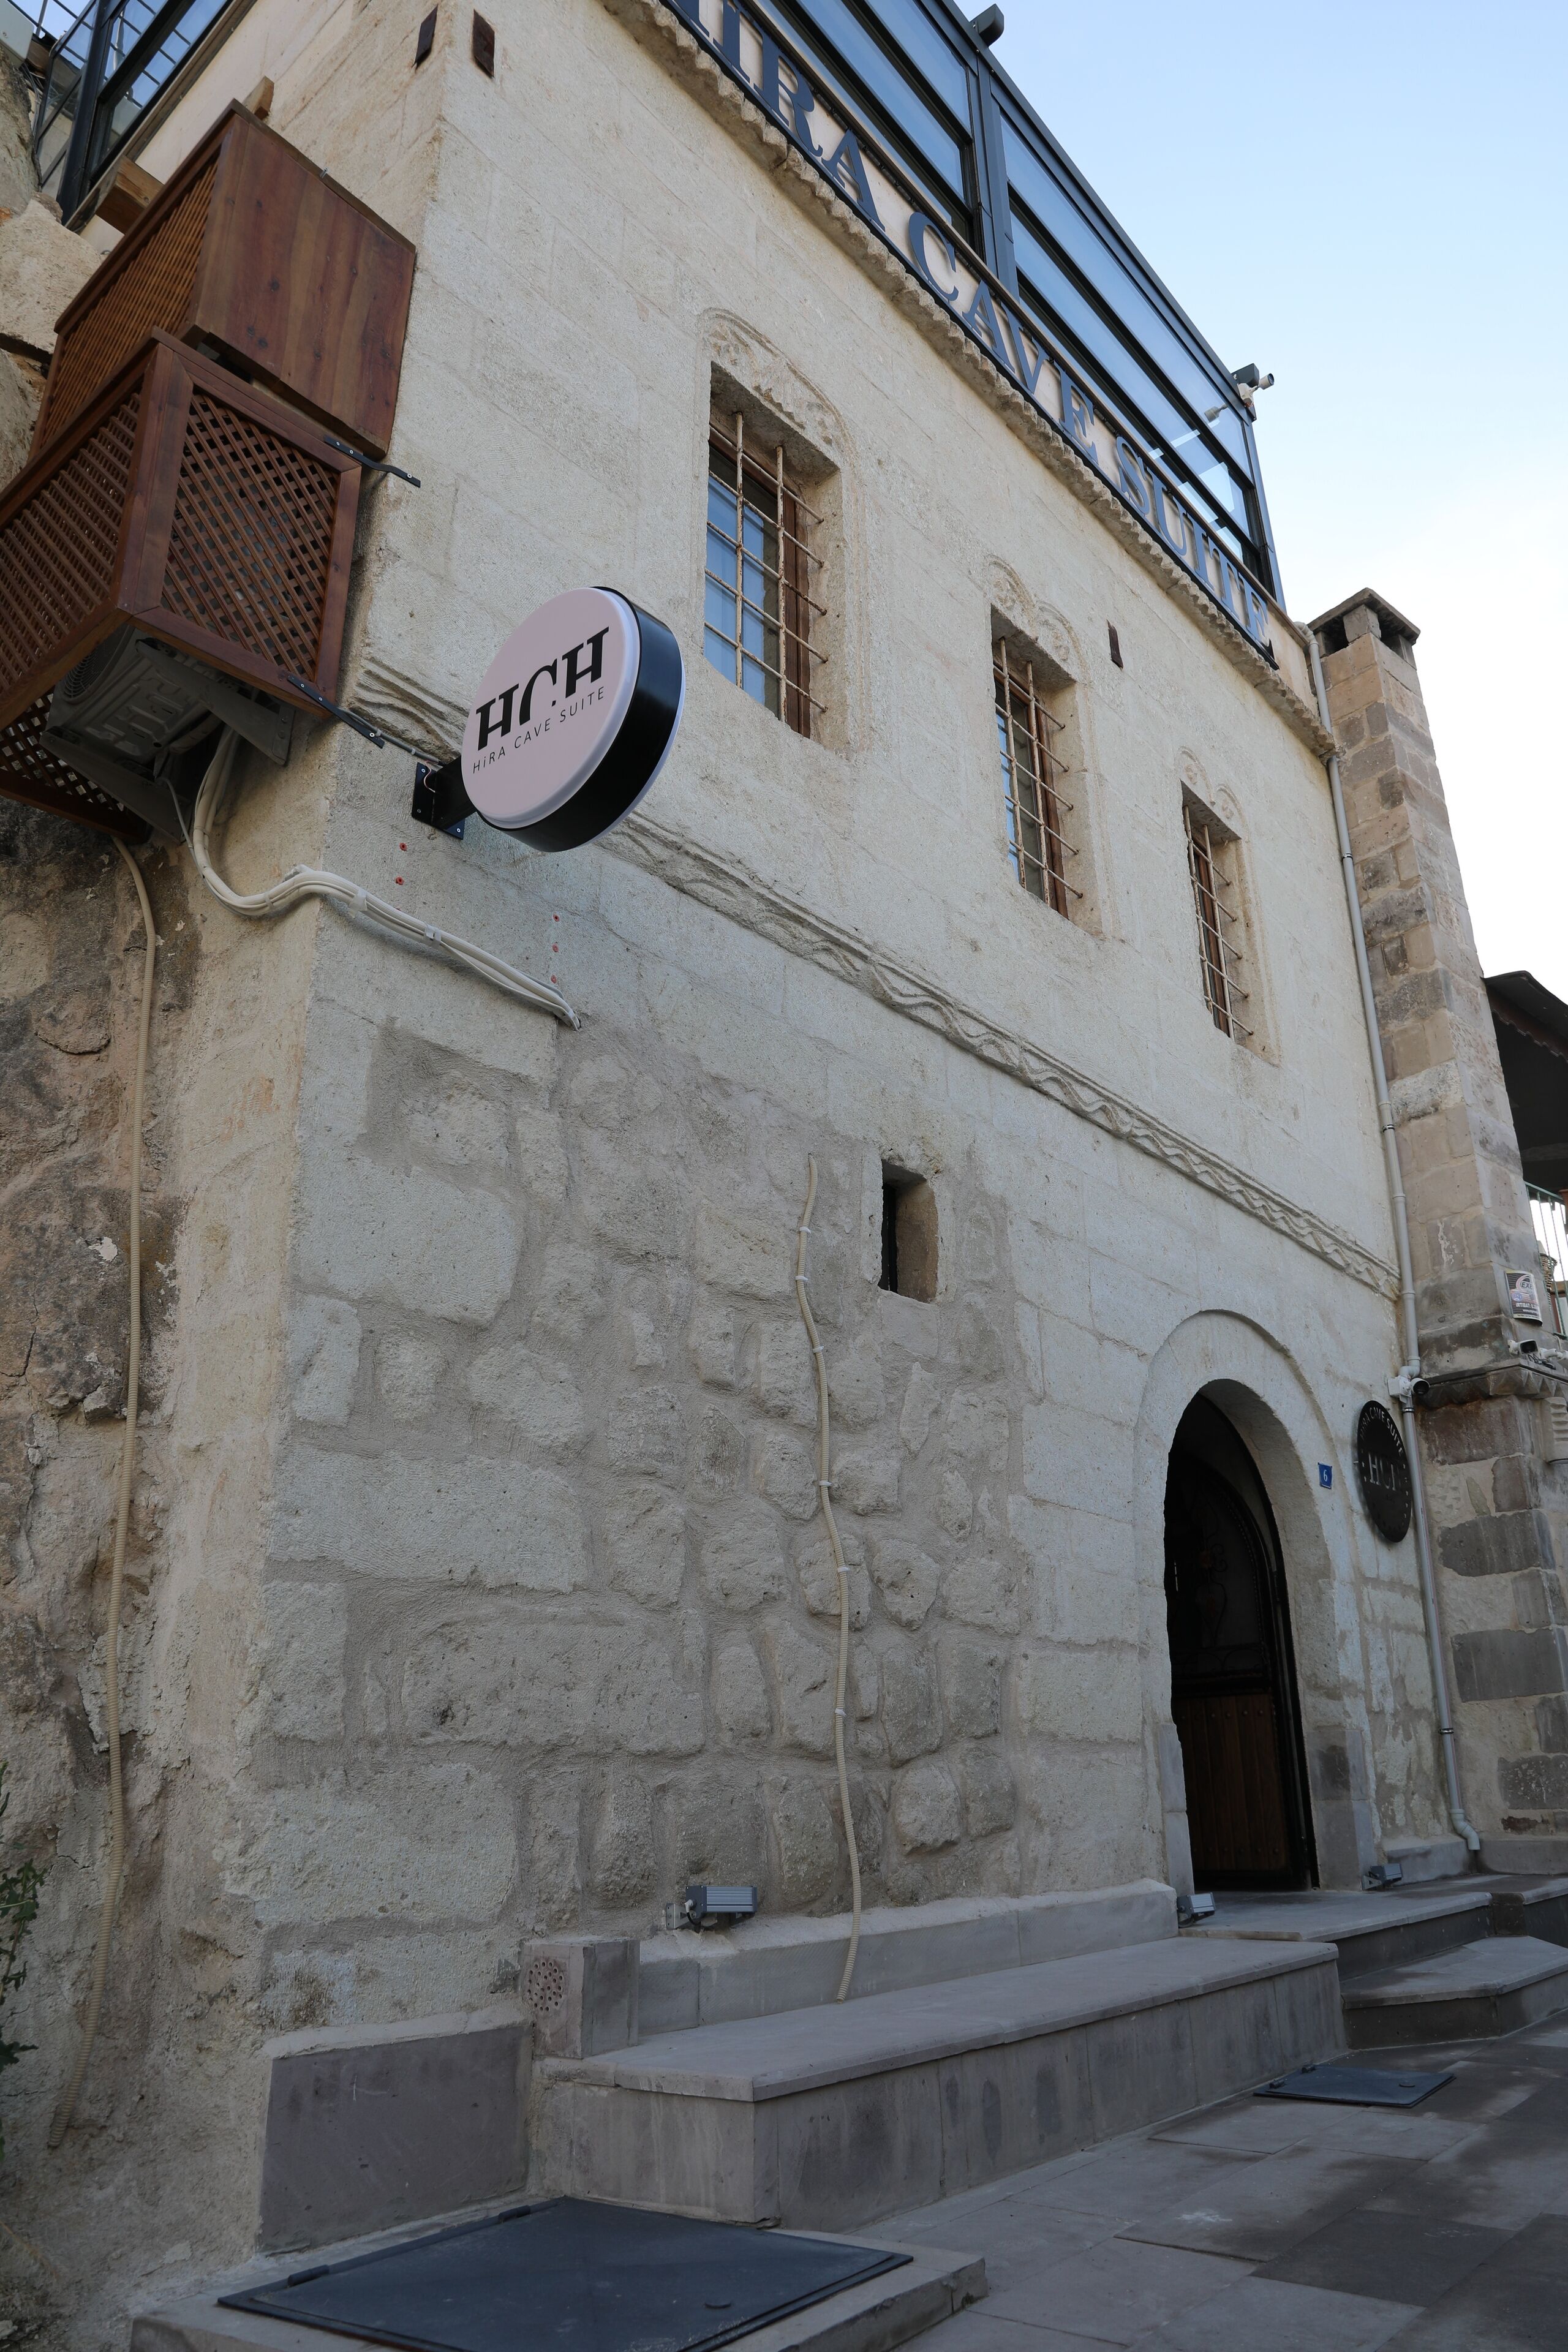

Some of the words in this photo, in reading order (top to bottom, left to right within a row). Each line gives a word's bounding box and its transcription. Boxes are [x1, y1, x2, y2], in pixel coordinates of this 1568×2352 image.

[670, 0, 886, 232] IRA
[908, 211, 1099, 466] CAVE
[1115, 435, 1275, 662] SUITE
[475, 626, 609, 752] HCH
[514, 718, 551, 749] CAVE
[559, 685, 605, 723] SUITE
[1386, 1417, 1404, 1457] SUITE
[1324, 1469, 1328, 1482] 6
